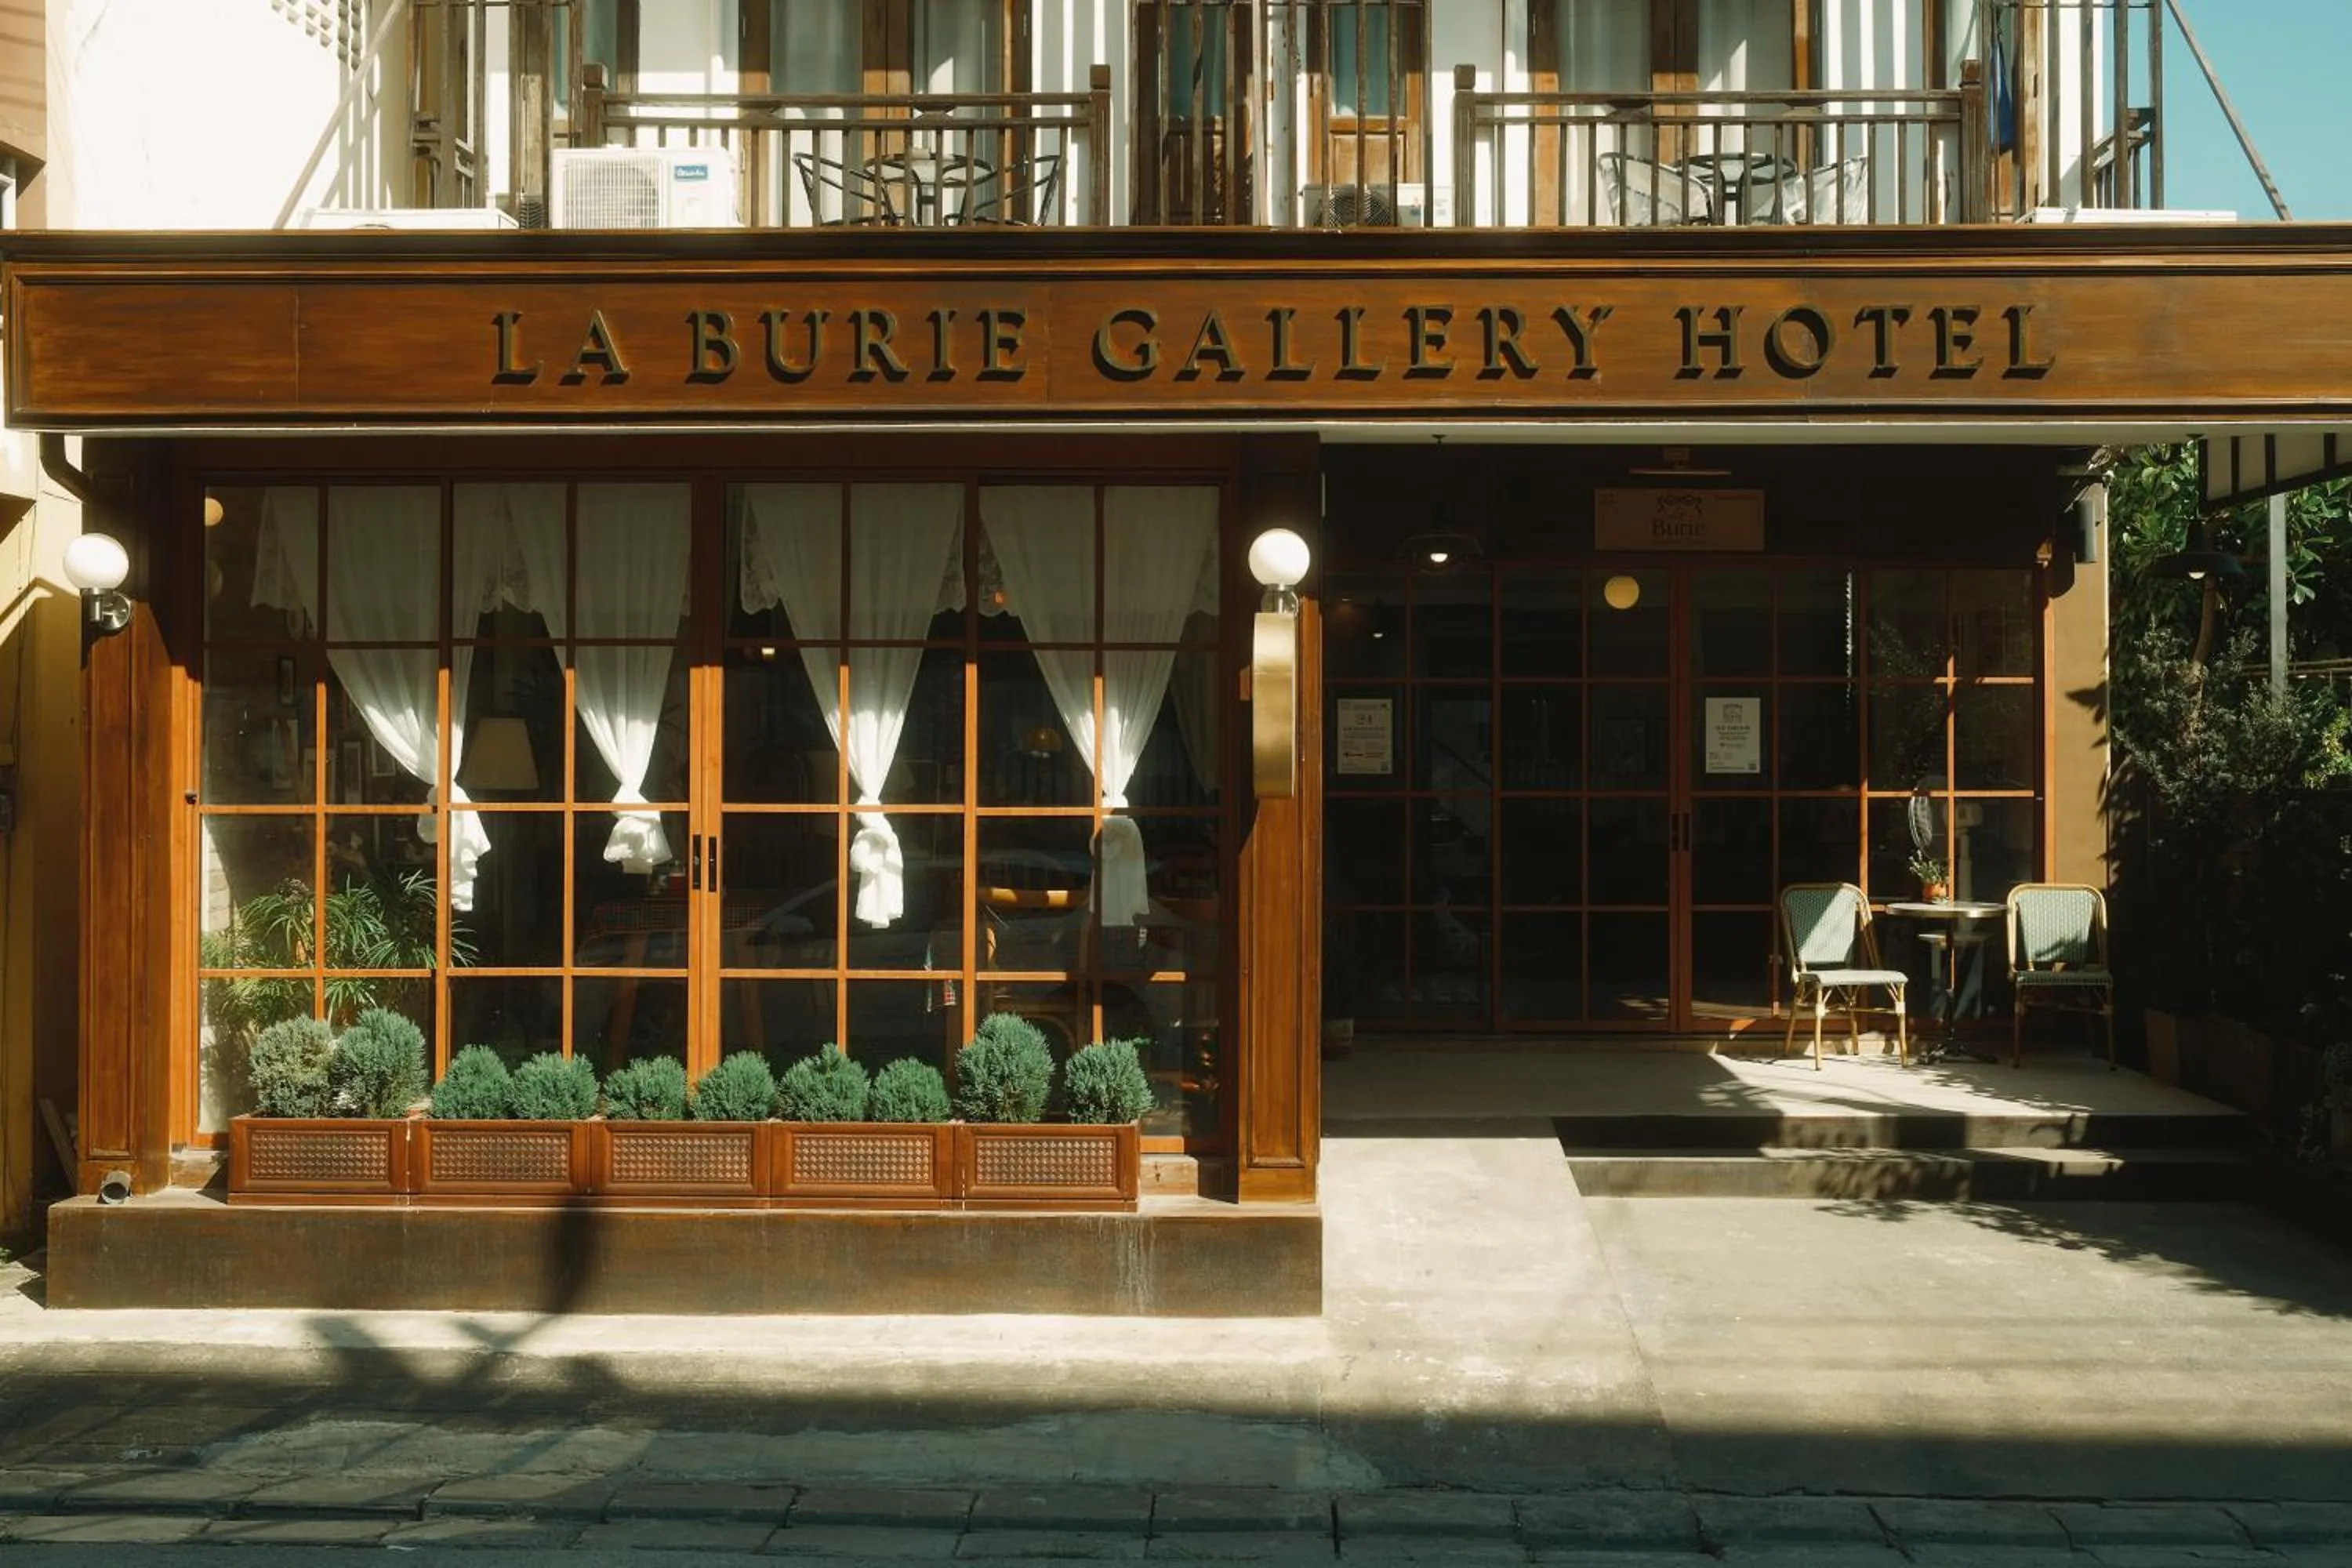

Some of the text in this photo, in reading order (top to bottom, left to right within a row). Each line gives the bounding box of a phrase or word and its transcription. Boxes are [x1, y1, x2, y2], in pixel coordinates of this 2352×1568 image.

[491, 304, 2056, 385] LA BURIE GALLERY HOTEL
[1652, 518, 1707, 538] Burie
